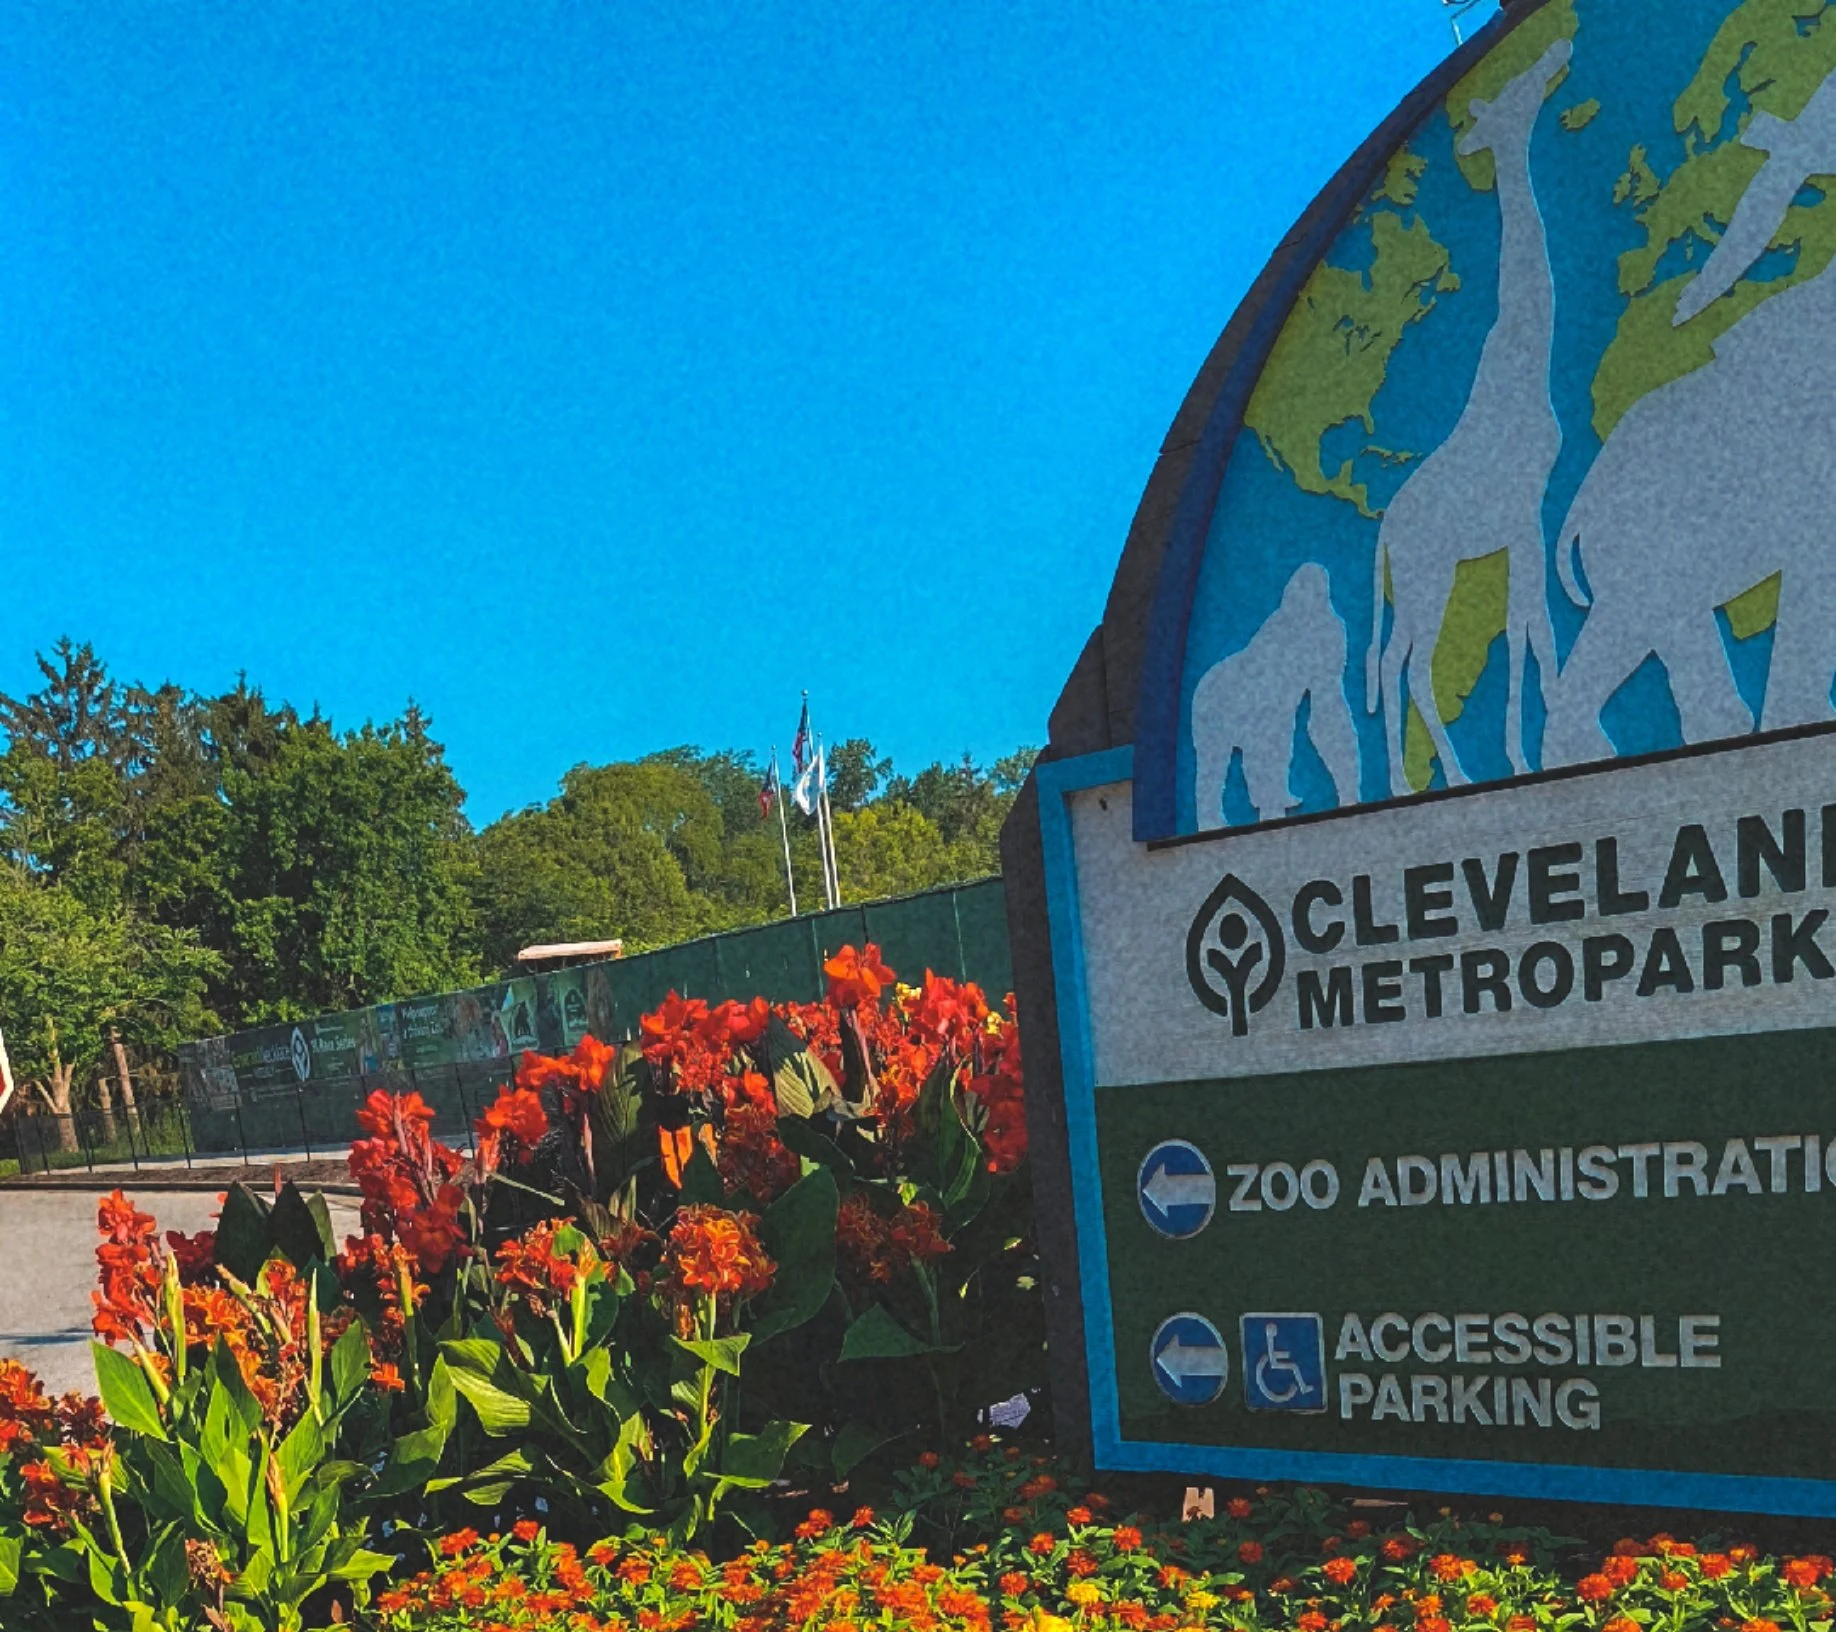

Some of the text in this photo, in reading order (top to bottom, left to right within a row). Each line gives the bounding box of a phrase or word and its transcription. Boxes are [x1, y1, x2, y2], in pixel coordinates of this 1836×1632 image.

[1227, 1135, 1836, 1211] ZOO ADMINISTRATI
[1334, 1312, 1722, 1369] ACCESSIBLE
[1339, 1374, 1601, 1431] PARKING
